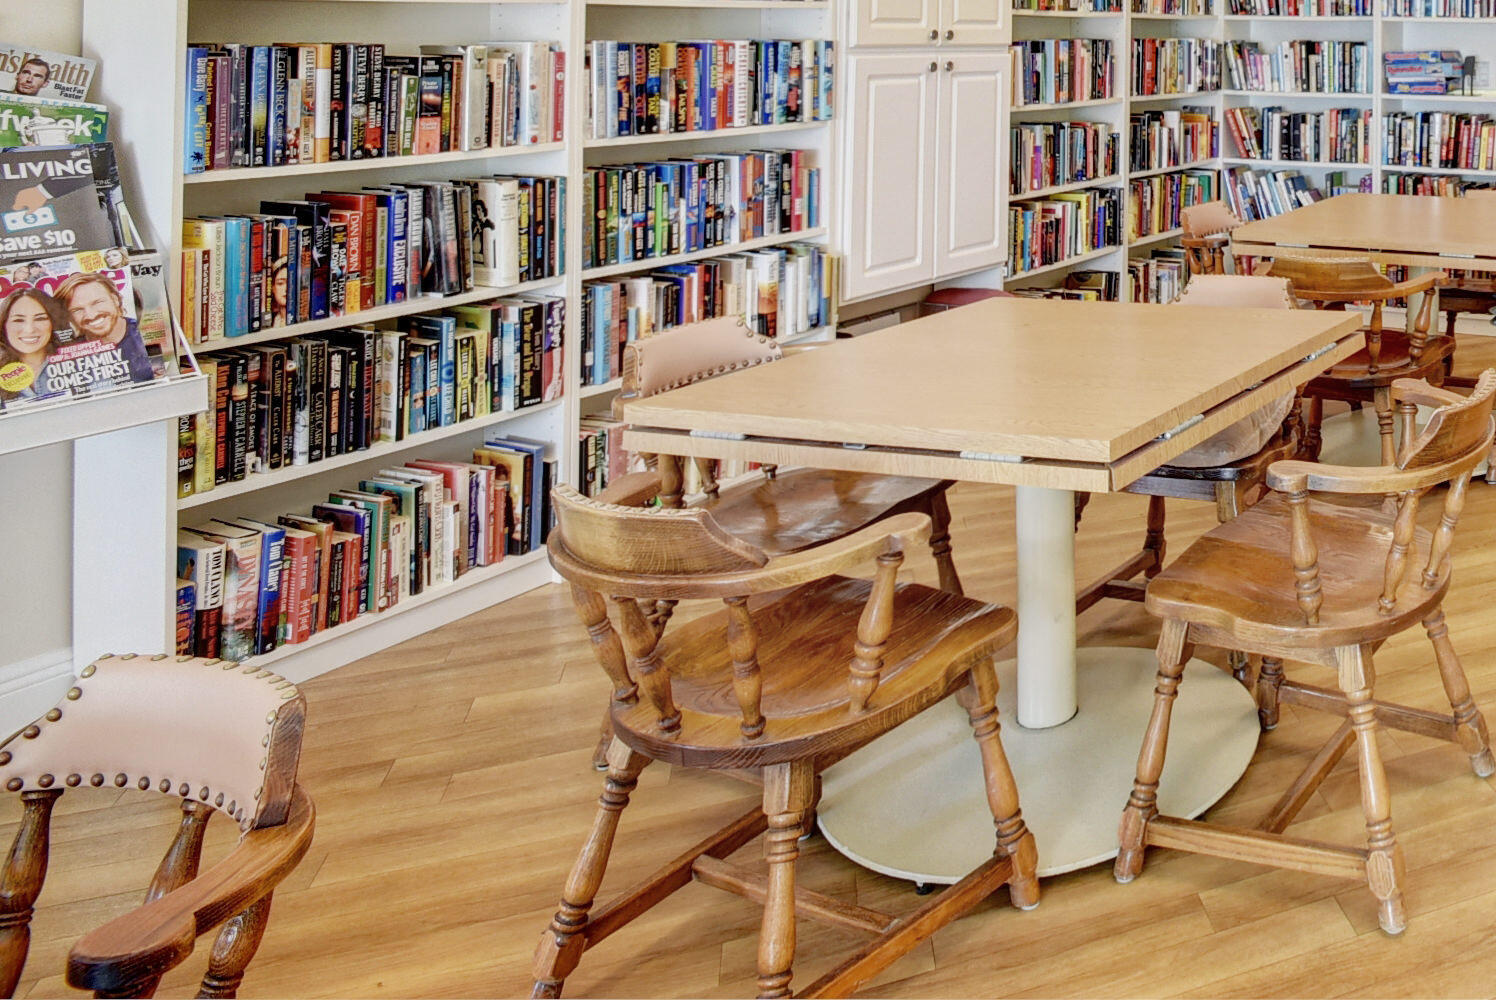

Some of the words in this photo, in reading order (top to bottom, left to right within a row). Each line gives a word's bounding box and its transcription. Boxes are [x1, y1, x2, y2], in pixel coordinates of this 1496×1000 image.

[23, 52, 90, 87] alth
[197, 58, 207, 73] Dave
[305, 50, 315, 65] ALEX
[357, 47, 366, 74] STEVE
[374, 47, 382, 69] STEVE
[193, 75, 207, 92] Barry
[258, 64, 266, 91] GLENN
[277, 62, 286, 92] GLENN
[305, 67, 314, 99] BERENSON
[333, 74, 341, 99] BERRY
[356, 75, 367, 103] BERRY
[373, 72, 381, 98] BERRY
[60, 91, 83, 99] Faster
[276, 95, 286, 116] BECK
[3, 159, 91, 179] LIVING
[411, 189, 422, 220] SANDRA
[350, 215, 360, 236] DAN
[44, 229, 76, 247] $10
[331, 244, 339, 273] BROWN
[349, 238, 359, 272] BROWN
[392, 240, 406, 286] EXCLUSIVE
[523, 309, 533, 322] The
[523, 324, 533, 341] Bear
[47, 361, 77, 375] OUR
[78, 348, 124, 367] FAMILY
[523, 356, 532, 371] The
[47, 371, 94, 391] COMES
[96, 360, 131, 378] FIRST
[217, 365, 230, 388] King
[364, 365, 372, 389] HEAT
[217, 390, 228, 409] Con
[250, 391, 258, 411] TRACE
[444, 384, 452, 394] LEE
[235, 401, 246, 429] STEPHEN
[315, 392, 323, 420] CALEB
[217, 412, 226, 436] STEPHEN
[250, 414, 256, 423] OF
[315, 422, 323, 445] CARR
[234, 436, 245, 472] CANNELL
[212, 549, 223, 568] TOM
[269, 540, 284, 560] Tom
[210, 570, 221, 607] CLANCY
[263, 561, 283, 592] Clancy
[234, 555, 257, 630] DYNASTY
